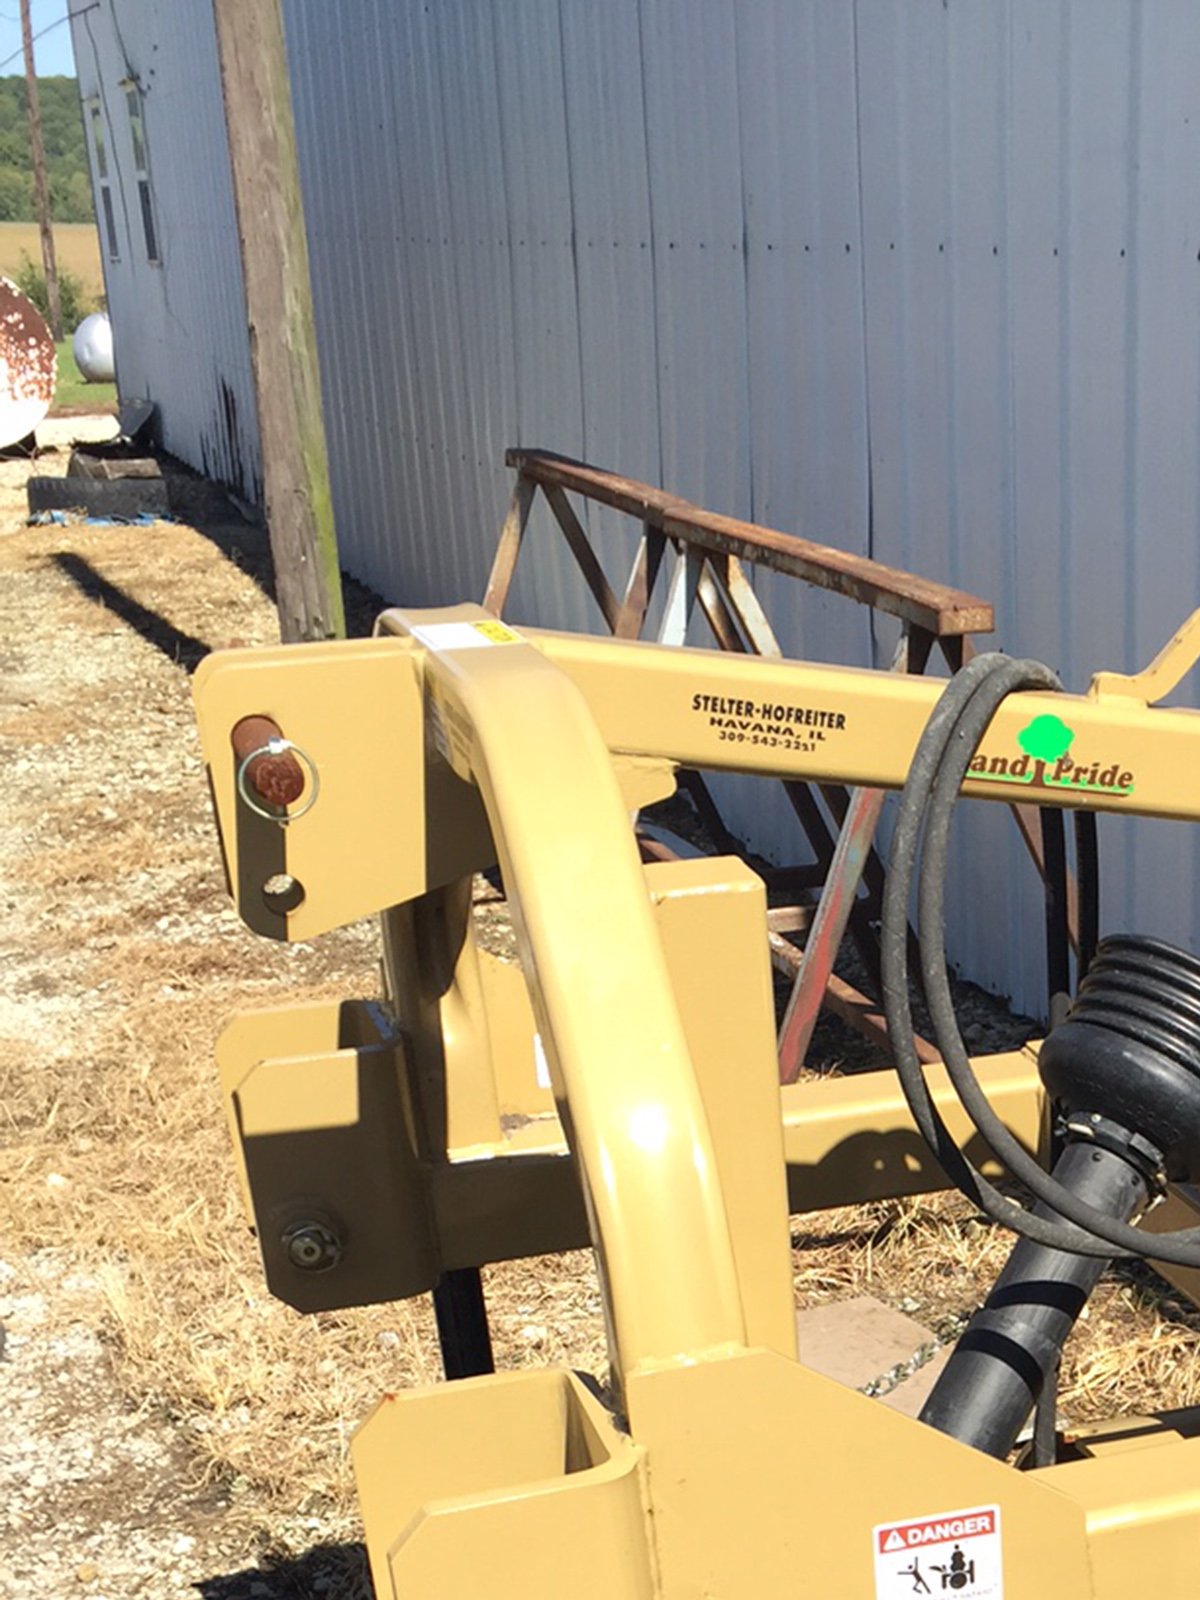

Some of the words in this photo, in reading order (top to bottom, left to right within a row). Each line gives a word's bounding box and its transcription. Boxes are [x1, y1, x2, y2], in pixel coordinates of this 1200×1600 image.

[692, 694, 845, 730] STELTER-HOFREITER
[709, 717, 801, 739] HAVANA,
[808, 730, 826, 741] IL
[970, 755, 1030, 777] and
[1053, 754, 1133, 788] Pride
[907, 1516, 990, 1545] DANGER
